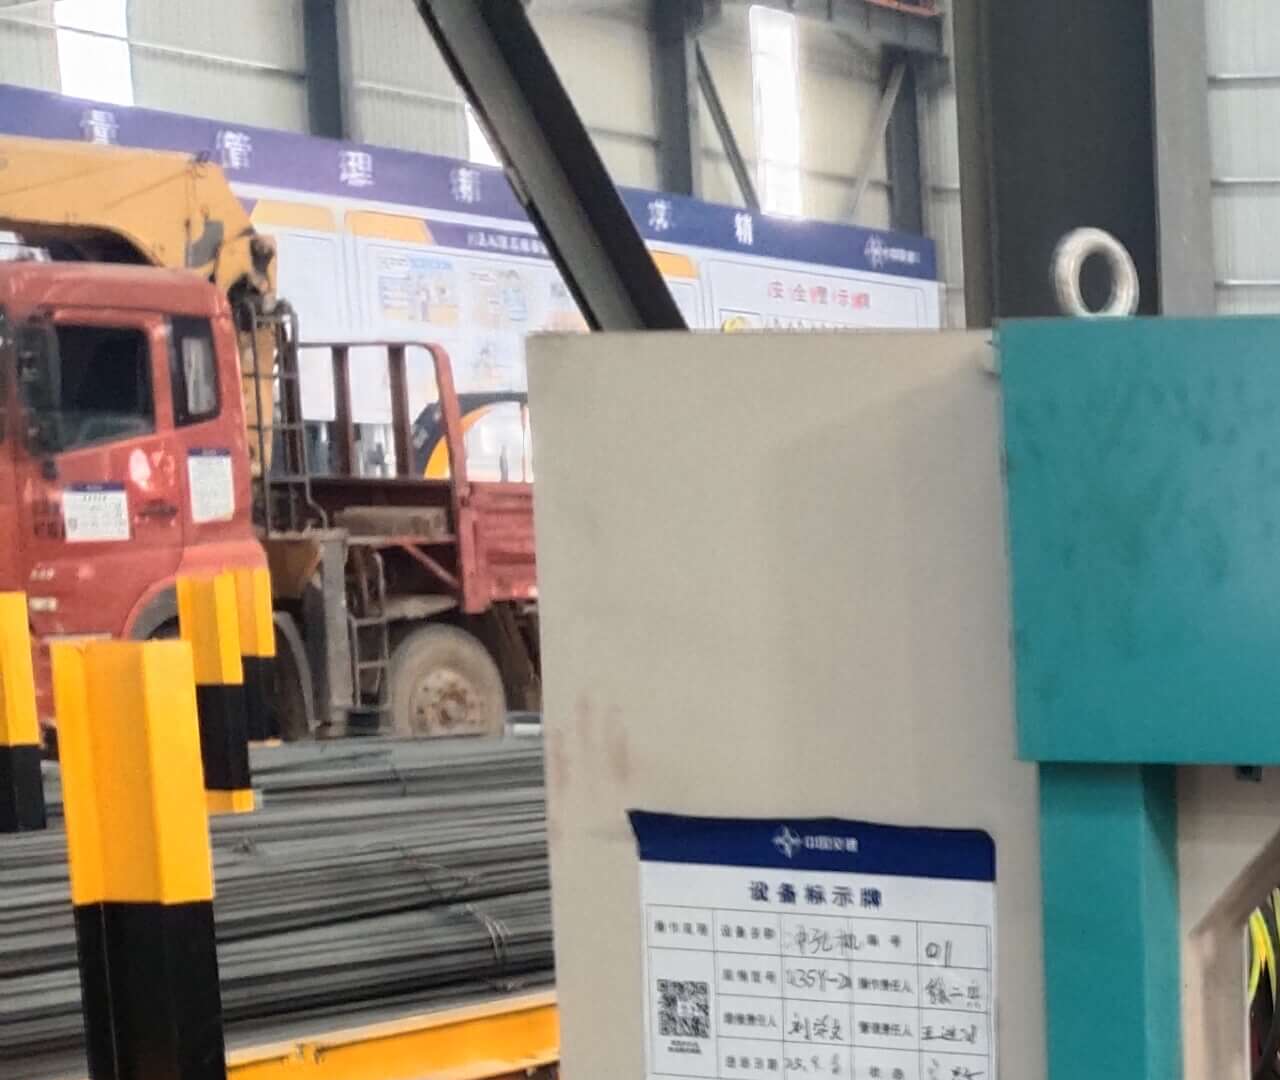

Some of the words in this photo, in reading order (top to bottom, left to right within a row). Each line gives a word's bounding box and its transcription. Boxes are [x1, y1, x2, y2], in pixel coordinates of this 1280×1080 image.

[750, 880, 883, 910] 设备标示牌
